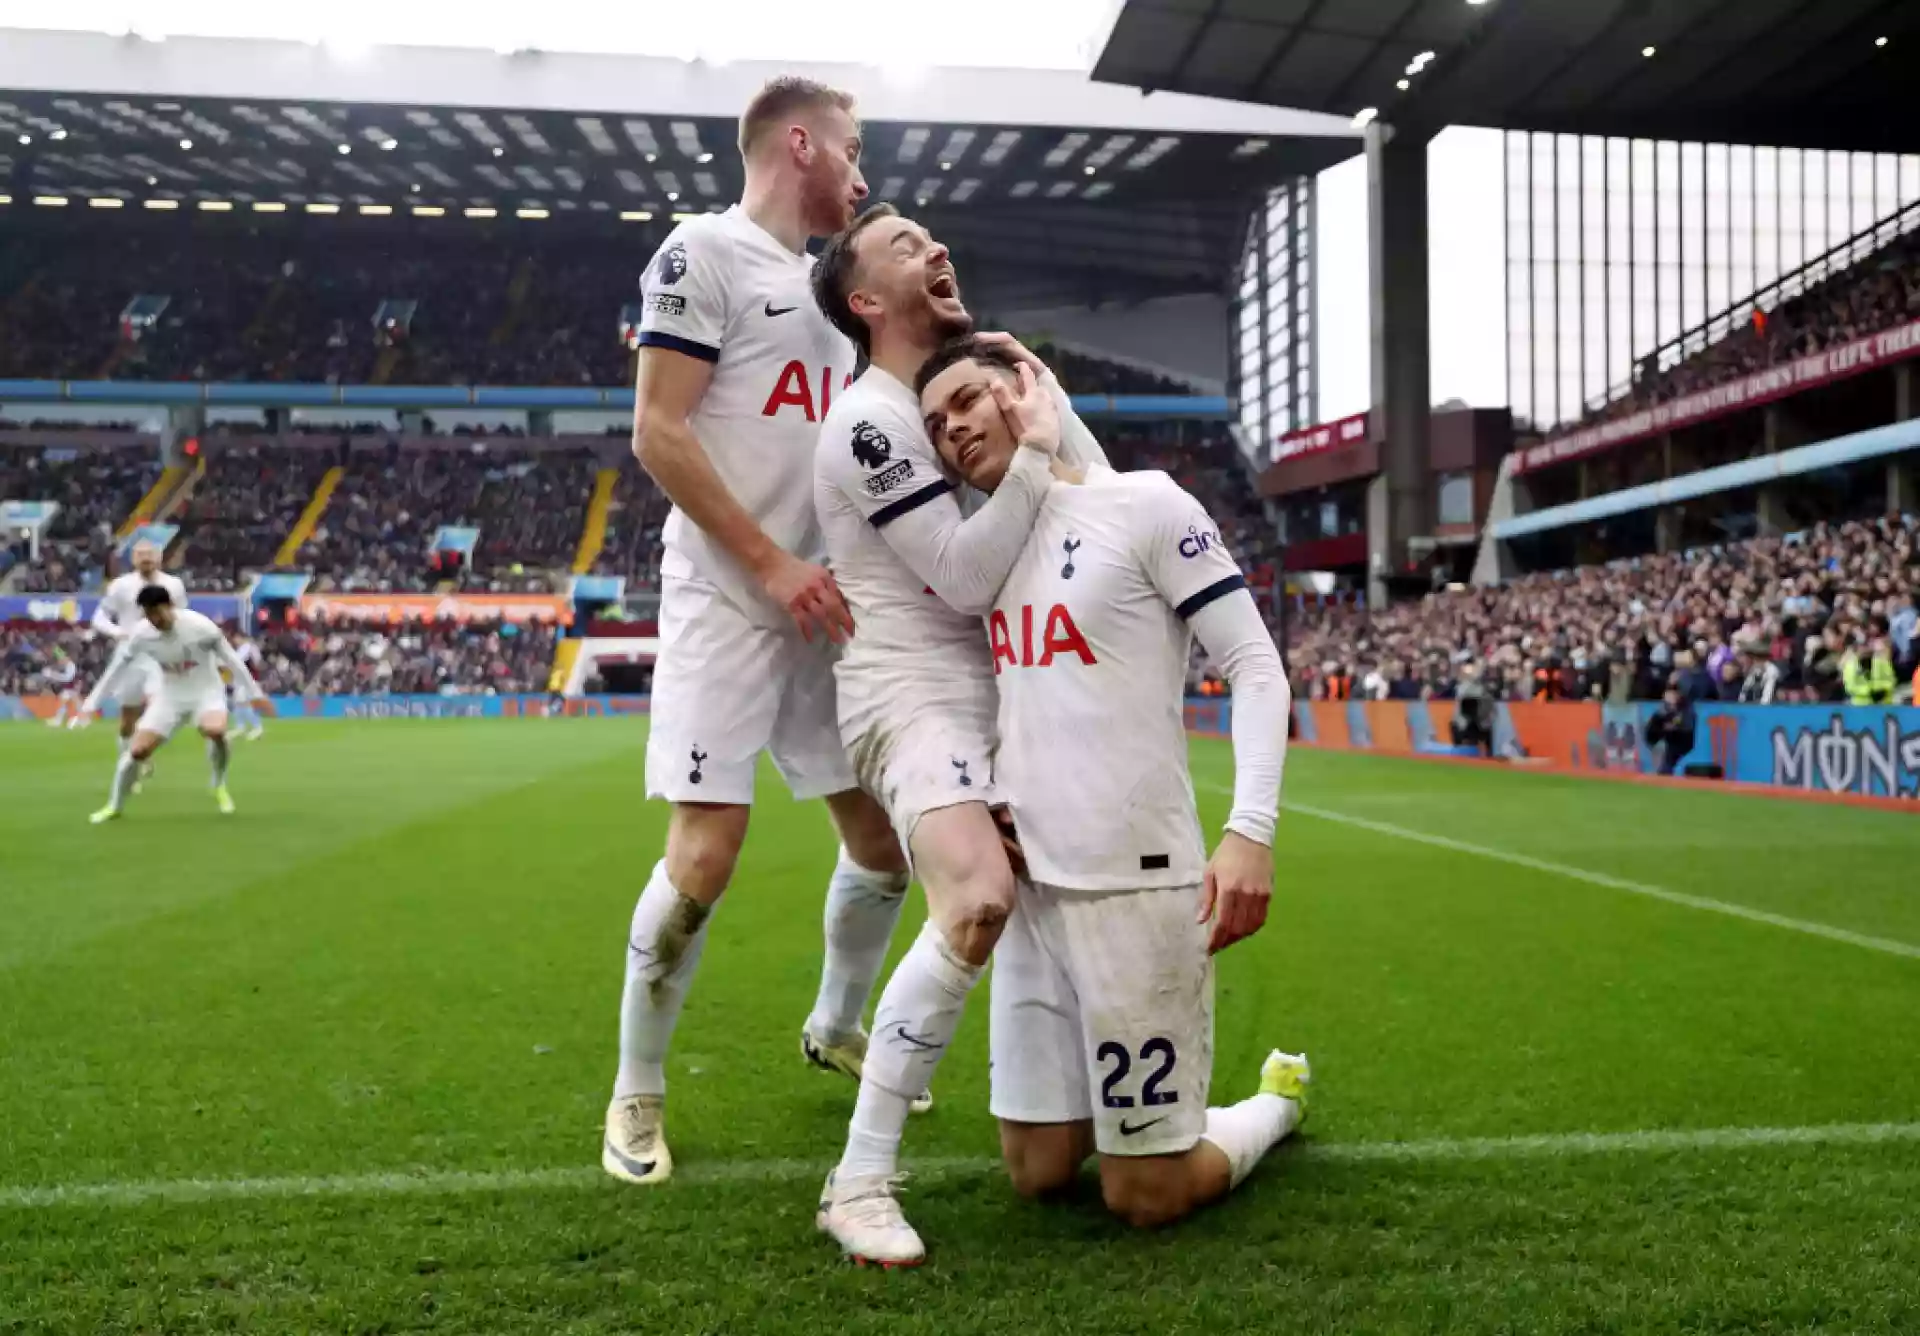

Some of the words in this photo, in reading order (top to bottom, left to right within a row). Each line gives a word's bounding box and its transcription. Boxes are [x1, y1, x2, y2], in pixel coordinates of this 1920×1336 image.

[762, 360, 852, 422] AI
[990, 604, 1098, 675] AIA
[1097, 1038, 1178, 1107] 22
